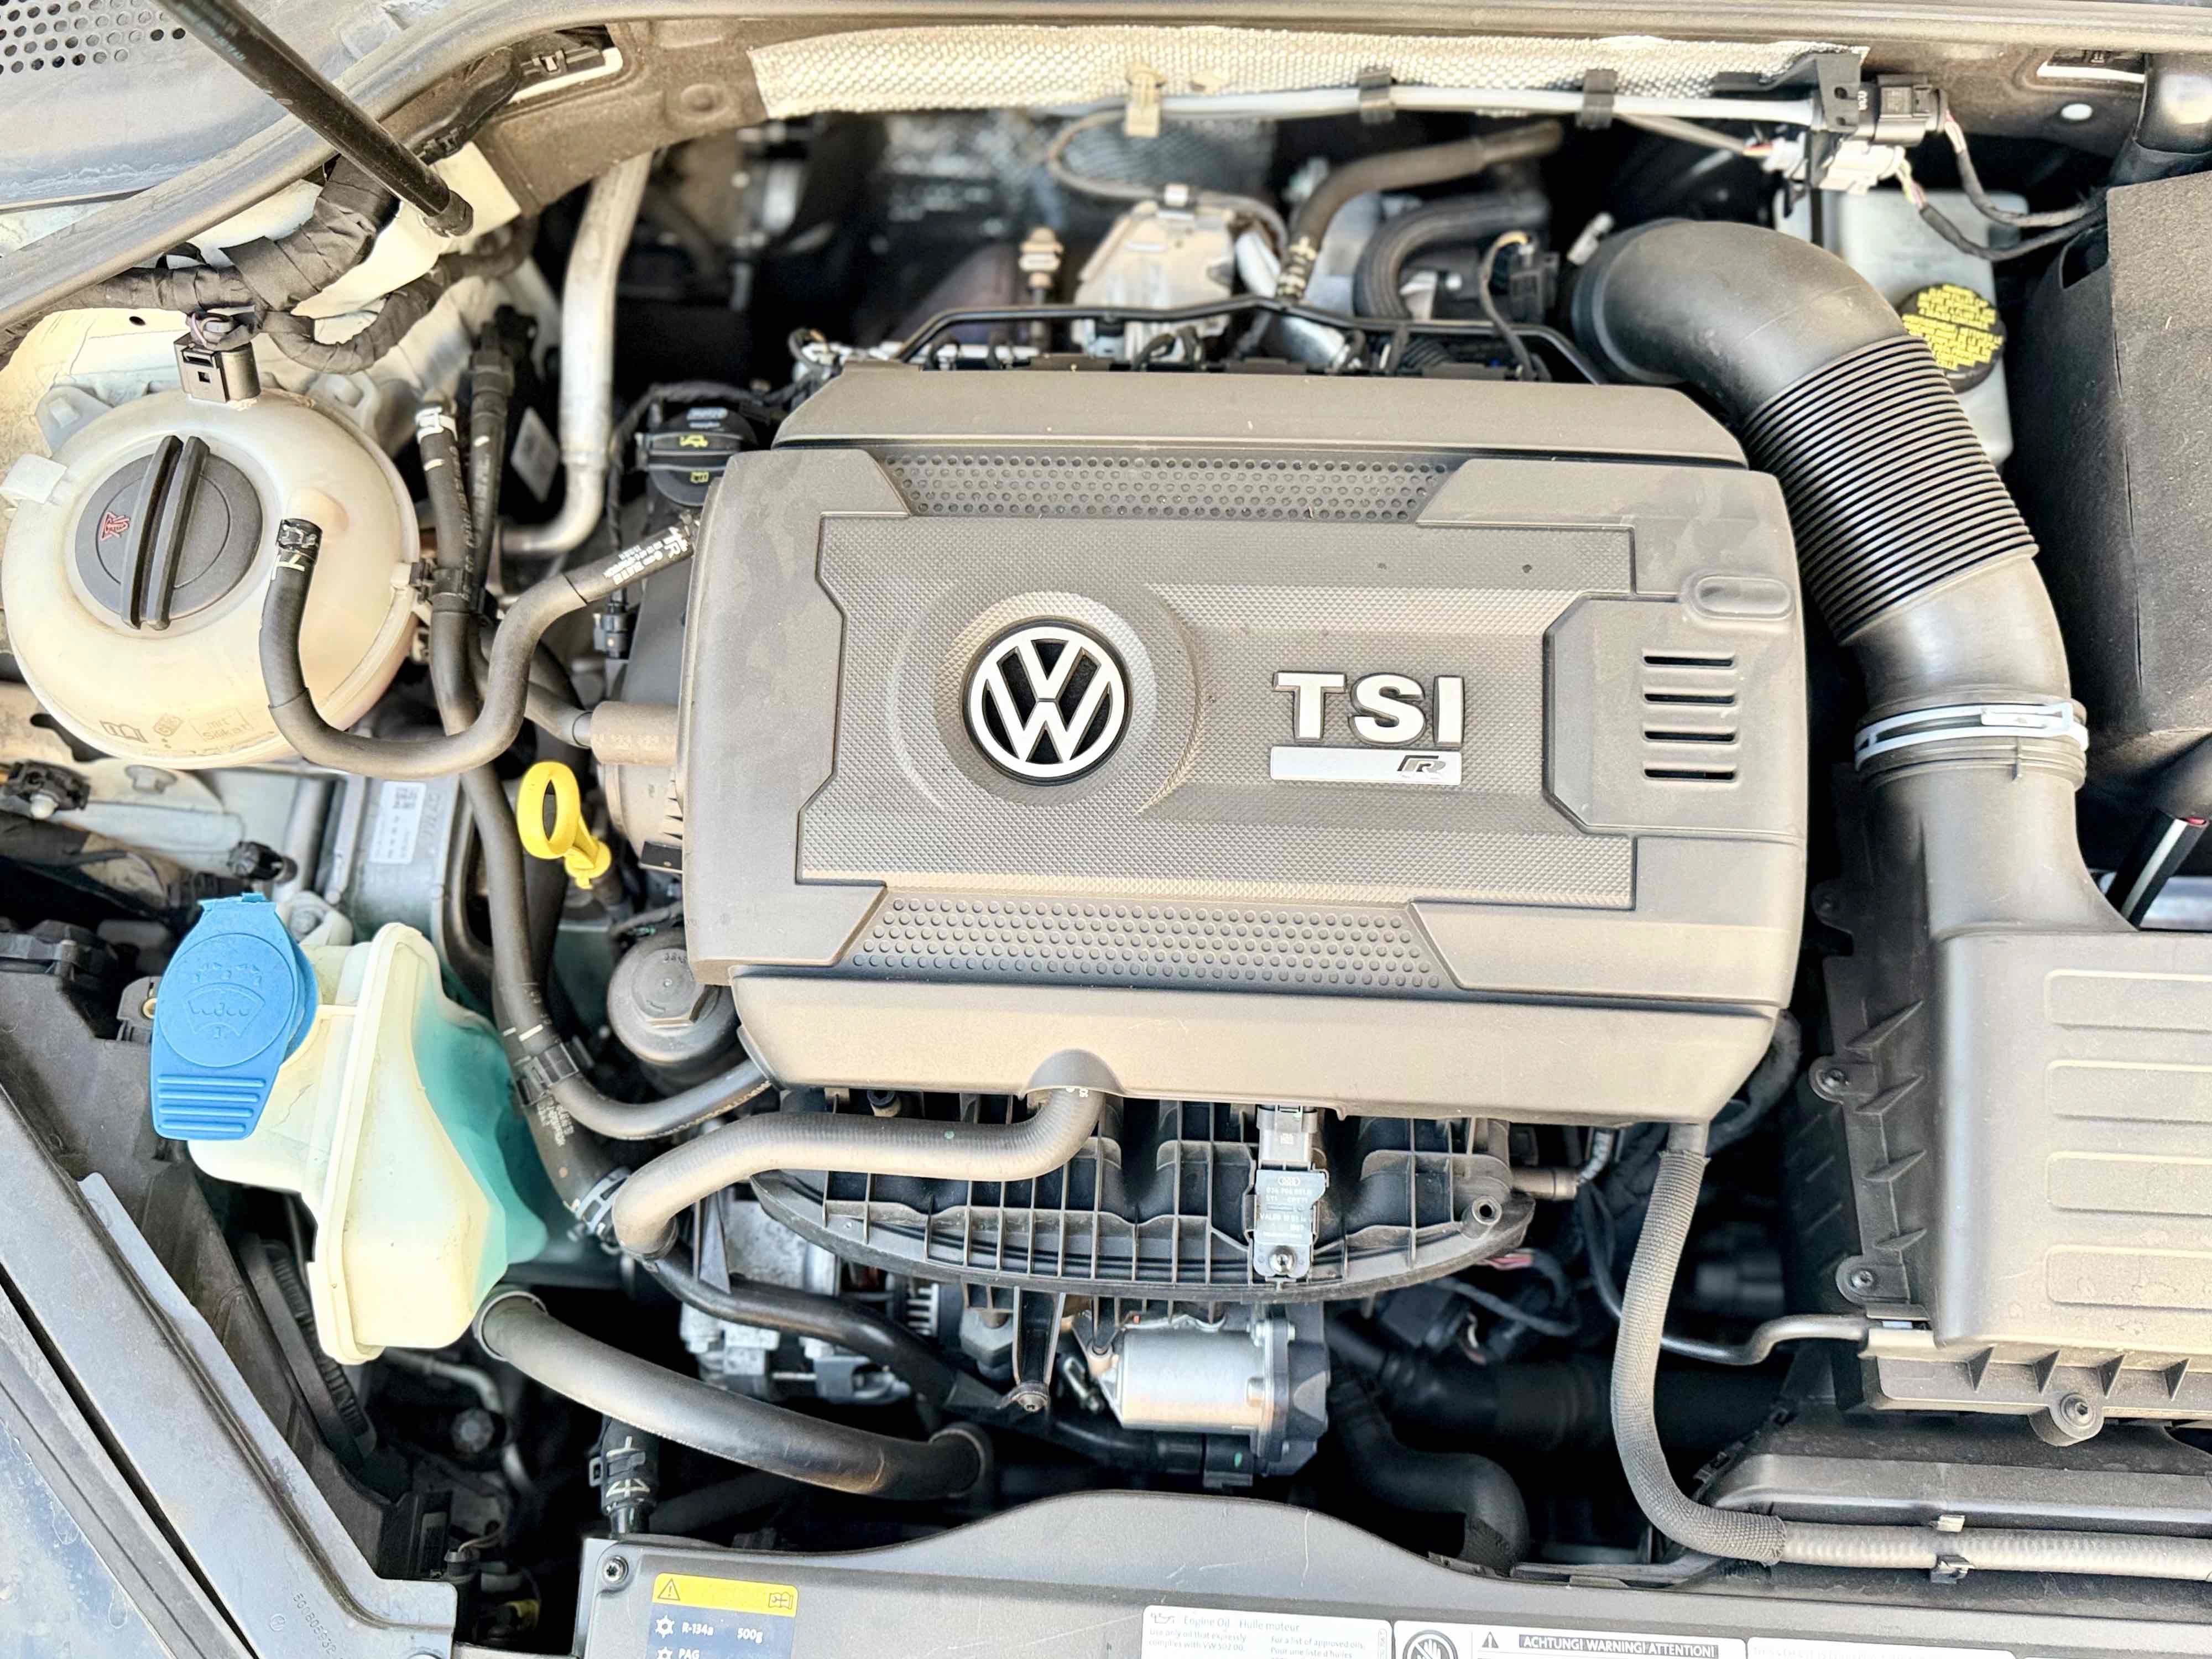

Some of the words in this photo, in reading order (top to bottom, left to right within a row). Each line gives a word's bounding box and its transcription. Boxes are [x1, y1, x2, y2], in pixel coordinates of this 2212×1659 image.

[1272, 671, 1465, 748] TSI
[1184, 1615, 1215, 1628] Engine
[682, 1622, 714, 1636] R-134a
[737, 1627, 763, 1644] 500g
[679, 1648, 700, 1659] PAG
[1523, 1635, 1584, 1651] ACHTUNG!
[1585, 1639, 1647, 1655] WARNING!
[1648, 1644, 1716, 1658] ATTENTION!
